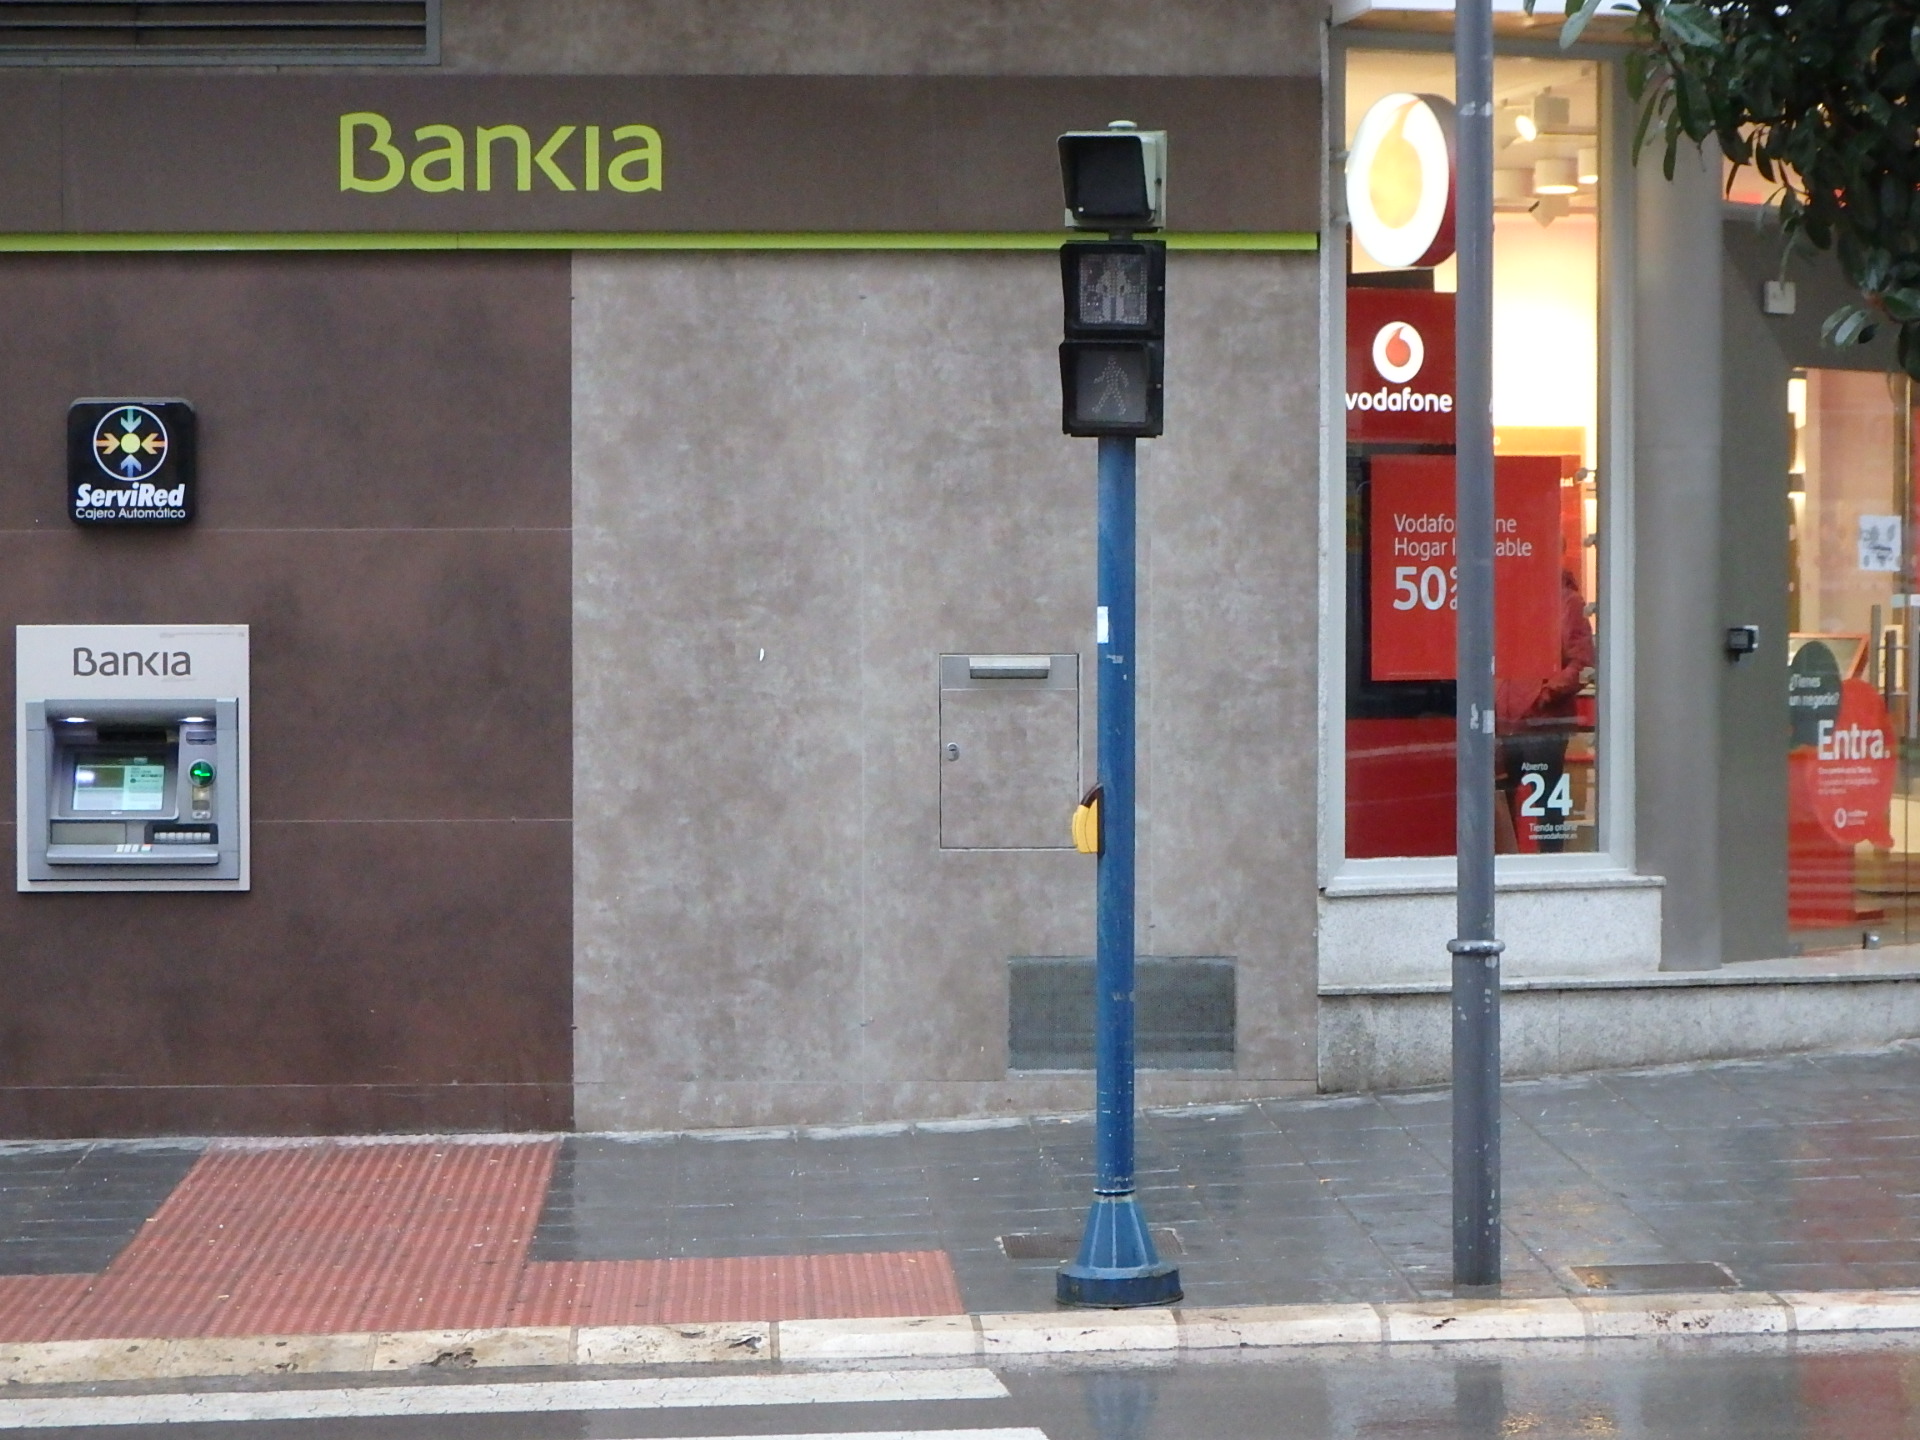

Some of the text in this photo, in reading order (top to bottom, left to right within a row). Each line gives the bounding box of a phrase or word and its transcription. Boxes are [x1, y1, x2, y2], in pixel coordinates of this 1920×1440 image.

[340, 112, 662, 192] Bankia
[1345, 387, 1453, 412] vodafone
[76, 482, 185, 507] ServiRed
[76, 506, 185, 520] Cajero Automático
[1394, 513, 1455, 532] Vodafo
[1395, 537, 1447, 561] Hogar
[73, 647, 191, 676] Bankia
[1818, 720, 1890, 760] Entra.
[1521, 773, 1573, 816] 24
